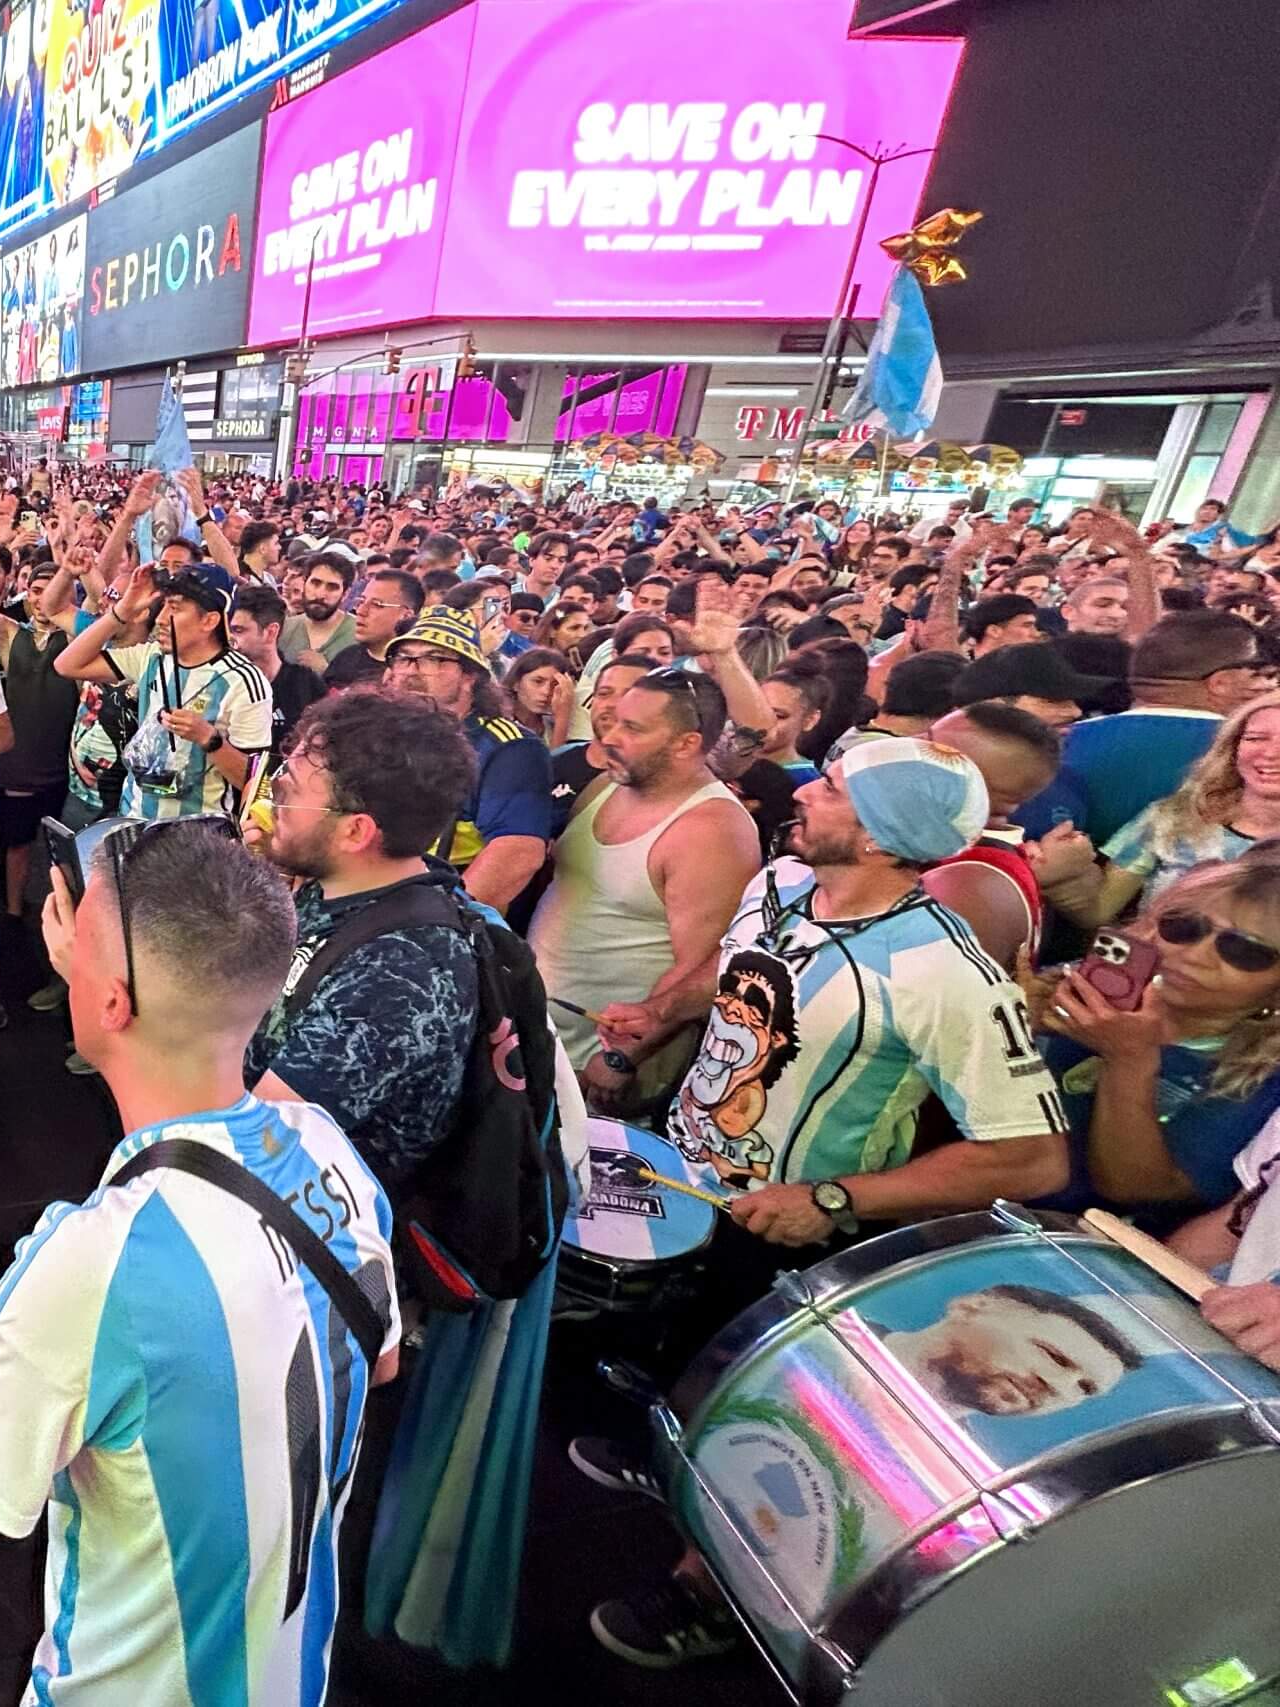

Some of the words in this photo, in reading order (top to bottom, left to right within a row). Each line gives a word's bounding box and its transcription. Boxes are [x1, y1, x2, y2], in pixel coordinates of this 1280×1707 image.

[574, 102, 728, 163] SAVE
[730, 102, 825, 162] ON
[289, 150, 360, 222] SAVE
[361, 128, 414, 195] ON
[508, 170, 702, 229] EVERY
[699, 169, 863, 228] PLAN
[90, 213, 242, 316] SEPHORA
[263, 208, 347, 277] EVERY
[347, 178, 438, 255] PLAN
[216, 418, 265, 437] SEPHORA
